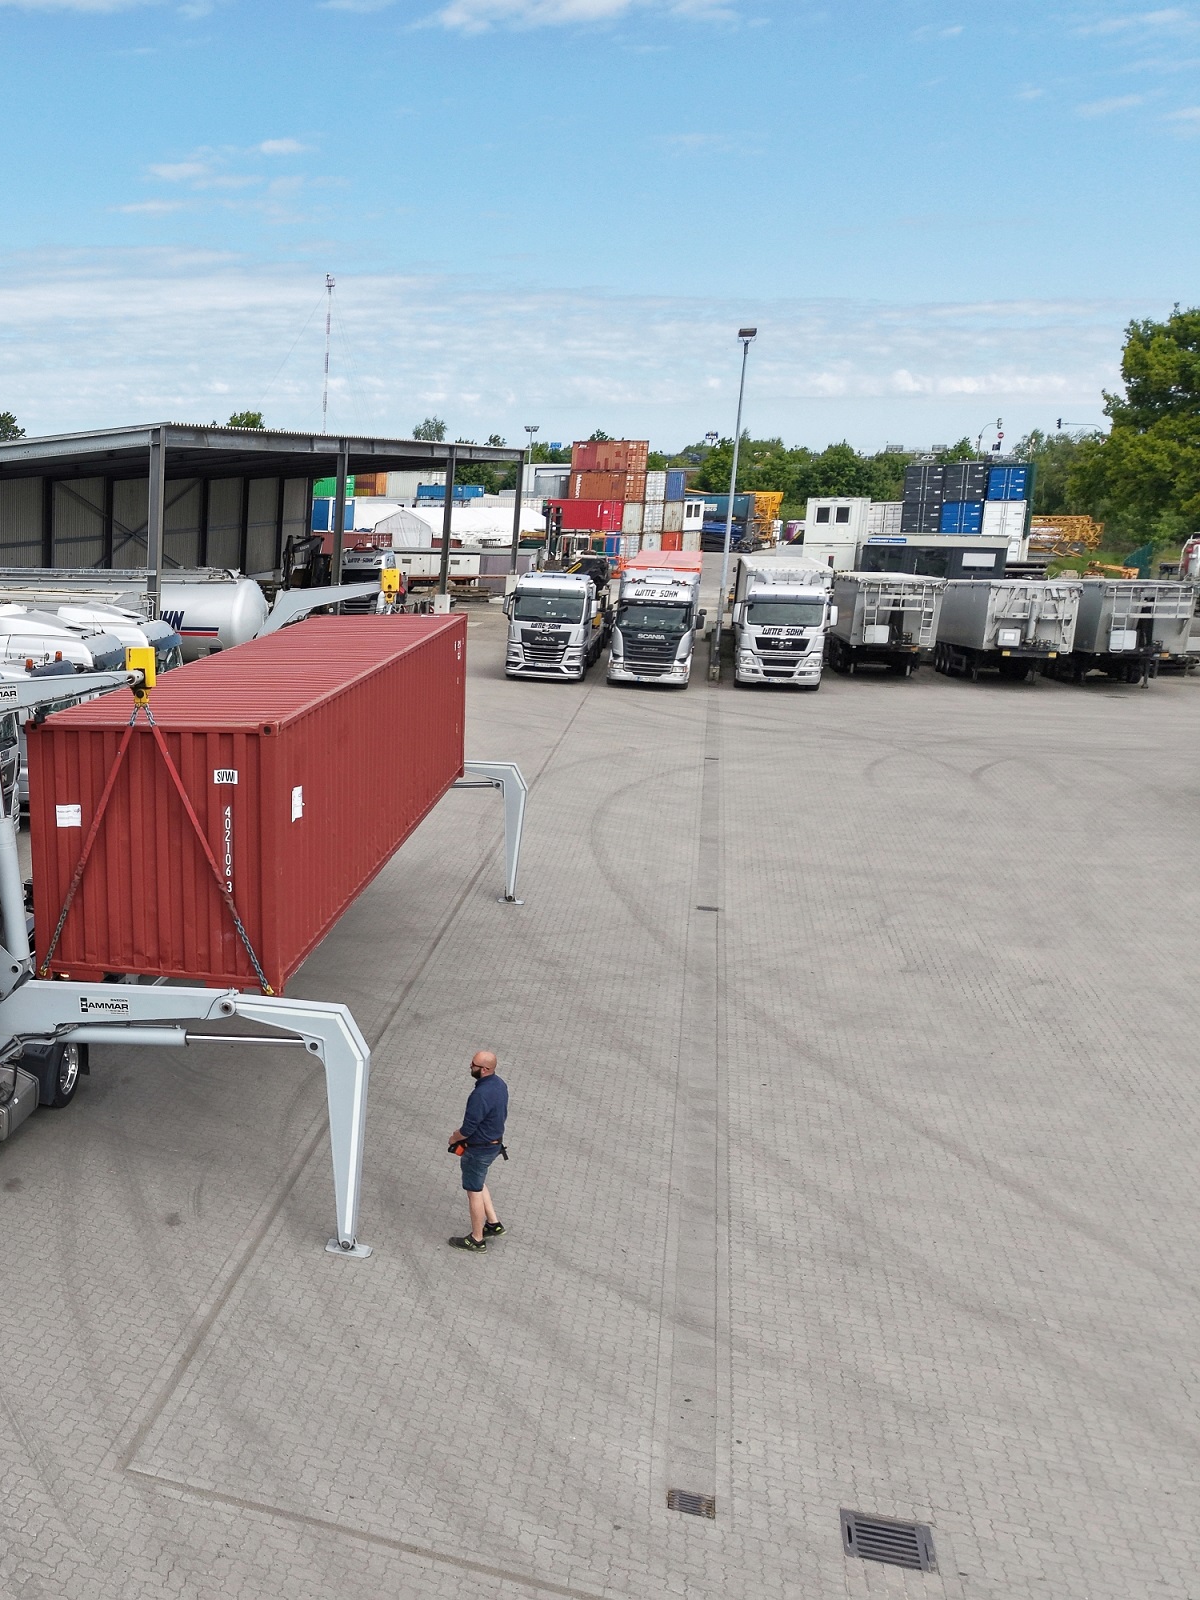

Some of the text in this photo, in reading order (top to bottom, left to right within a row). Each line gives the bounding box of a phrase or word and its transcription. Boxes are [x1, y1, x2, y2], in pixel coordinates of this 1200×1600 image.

[574, 474, 582, 499] Matson
[635, 588, 679, 598] WITTE SOHN
[762, 627, 804, 636] WITTE SOHN
[224, 806, 232, 877] 402106
[80, 999, 129, 1011] HAMMAR
